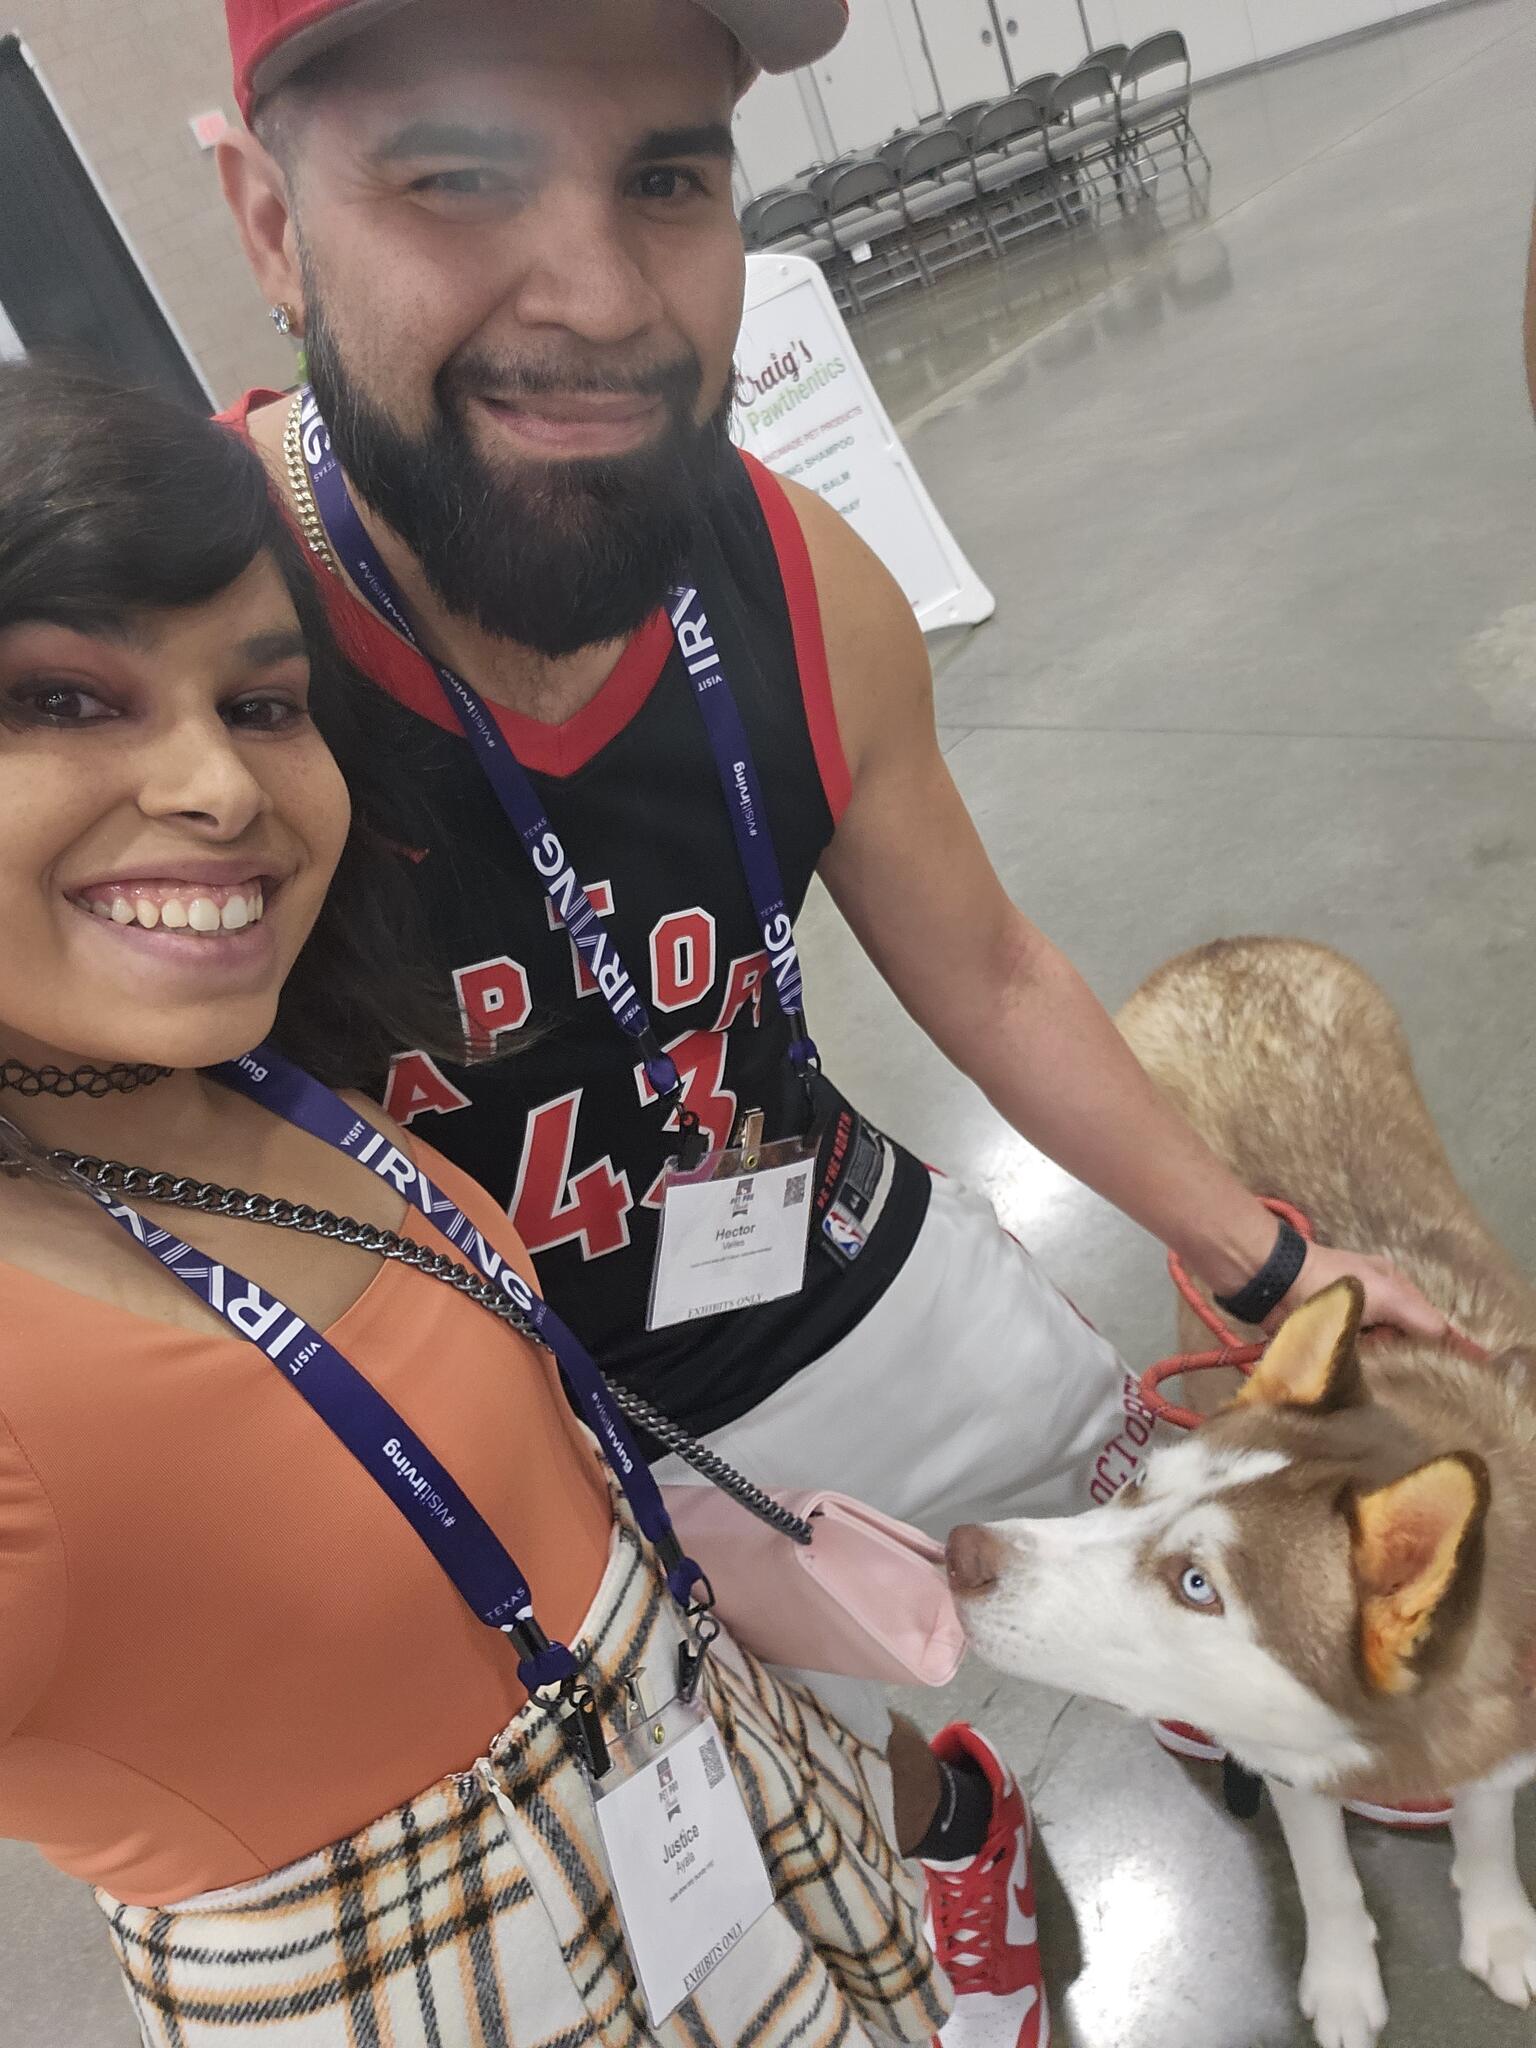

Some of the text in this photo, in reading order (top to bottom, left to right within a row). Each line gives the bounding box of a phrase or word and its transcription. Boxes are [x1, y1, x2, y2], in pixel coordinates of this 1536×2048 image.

[734, 339, 814, 409] Craig's
[745, 355, 847, 436] Pawthentics
[804, 435, 855, 470] SHAMPOO
[698, 673, 723, 692] VISIT
[523, 817, 548, 840] TEXAS
[532, 832, 637, 1014] IRVING
[759, 900, 784, 918] TEXAS
[621, 1003, 642, 1026] VISIT
[339, 1120, 366, 1147] VISIT
[508, 1030, 738, 1263] 43
[357, 1132, 534, 1311] IRVING
[715, 1223, 756, 1241] Hector
[288, 1341, 322, 1376] VISIT
[485, 1587, 526, 1621] TEXAS
[662, 1822, 701, 1865] Justice
[682, 1941, 724, 1993] EXHIBITS
[720, 1920, 745, 1953] ONLY
